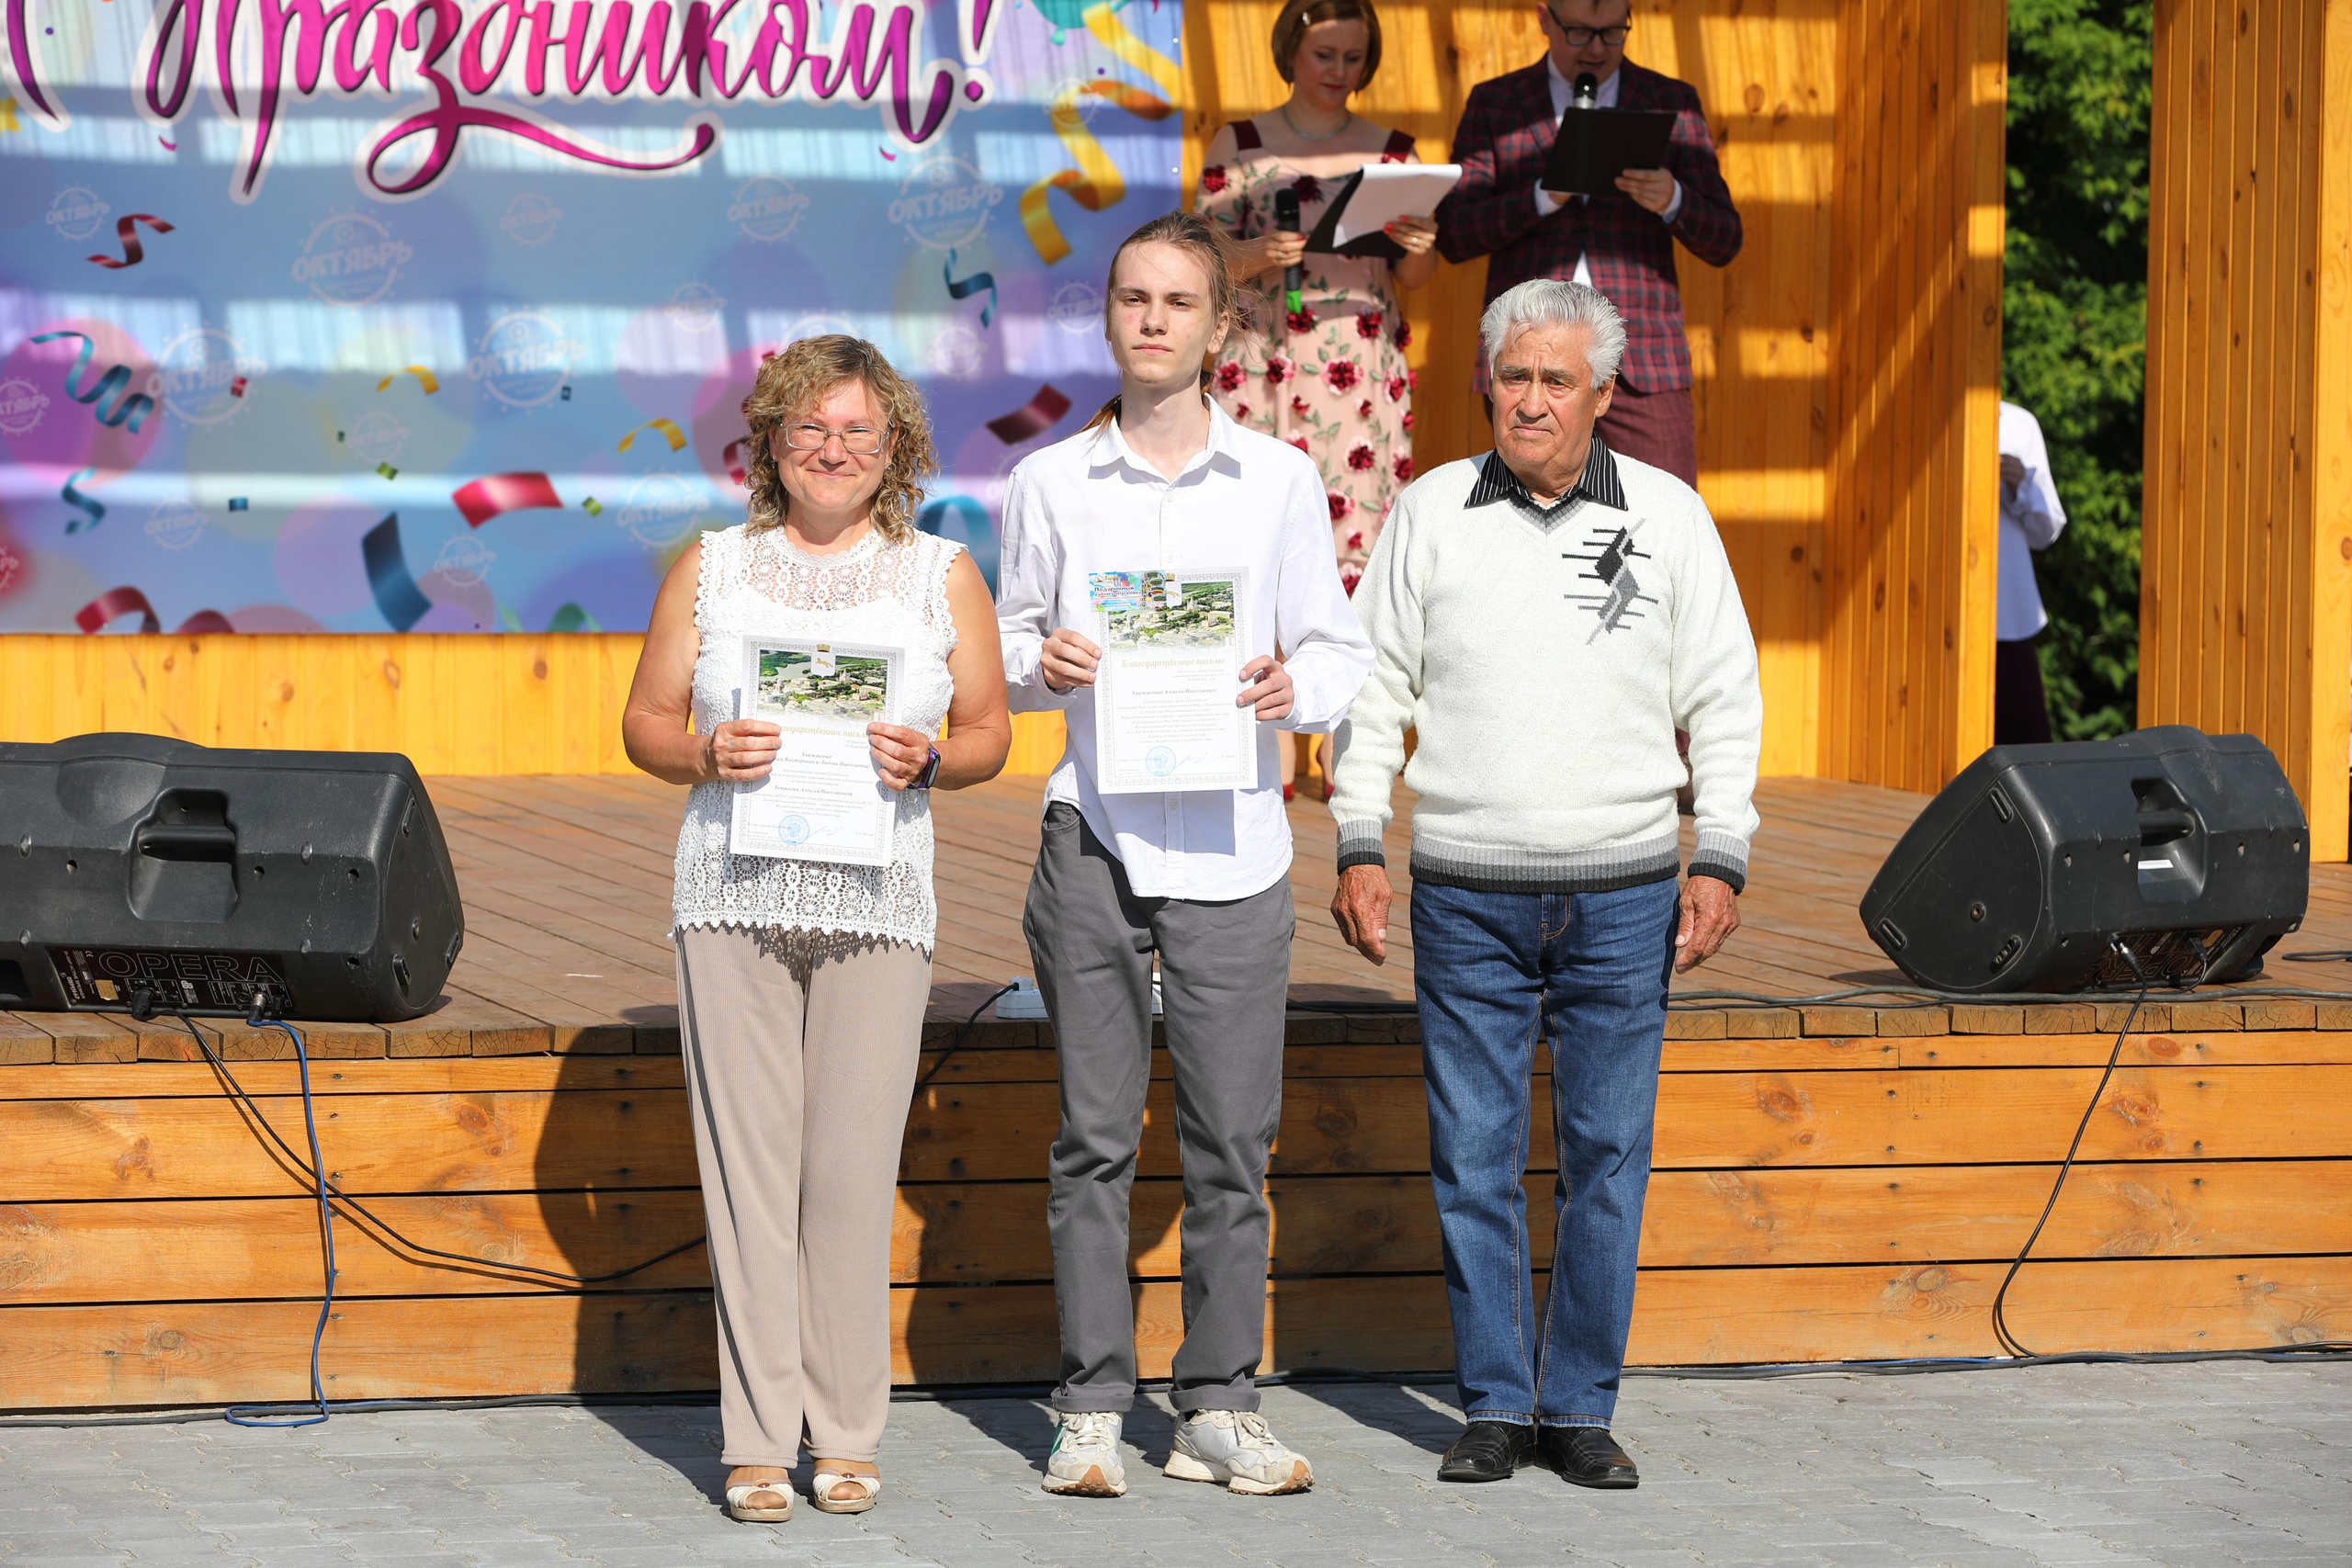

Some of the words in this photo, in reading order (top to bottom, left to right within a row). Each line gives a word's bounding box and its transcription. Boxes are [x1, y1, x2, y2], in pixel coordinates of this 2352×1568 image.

[46, 201, 110, 224] ОКТЯБРЬ
[727, 185, 811, 222] ОКТЯБРЬ
[887, 180, 1004, 225] ОКТЯБРЬ
[291, 239, 413, 284] ОКТЯБРЬ
[146, 353, 268, 399] ОКТЯБРЬ
[467, 338, 587, 383] ОКТЯБРЬ
[616, 493, 710, 526] ОКТЯБРЬ
[434, 550, 497, 572] ОКТЯБРЬ
[1121, 659, 1194, 669] Благодарственное
[98, 952, 285, 983] OPERA
